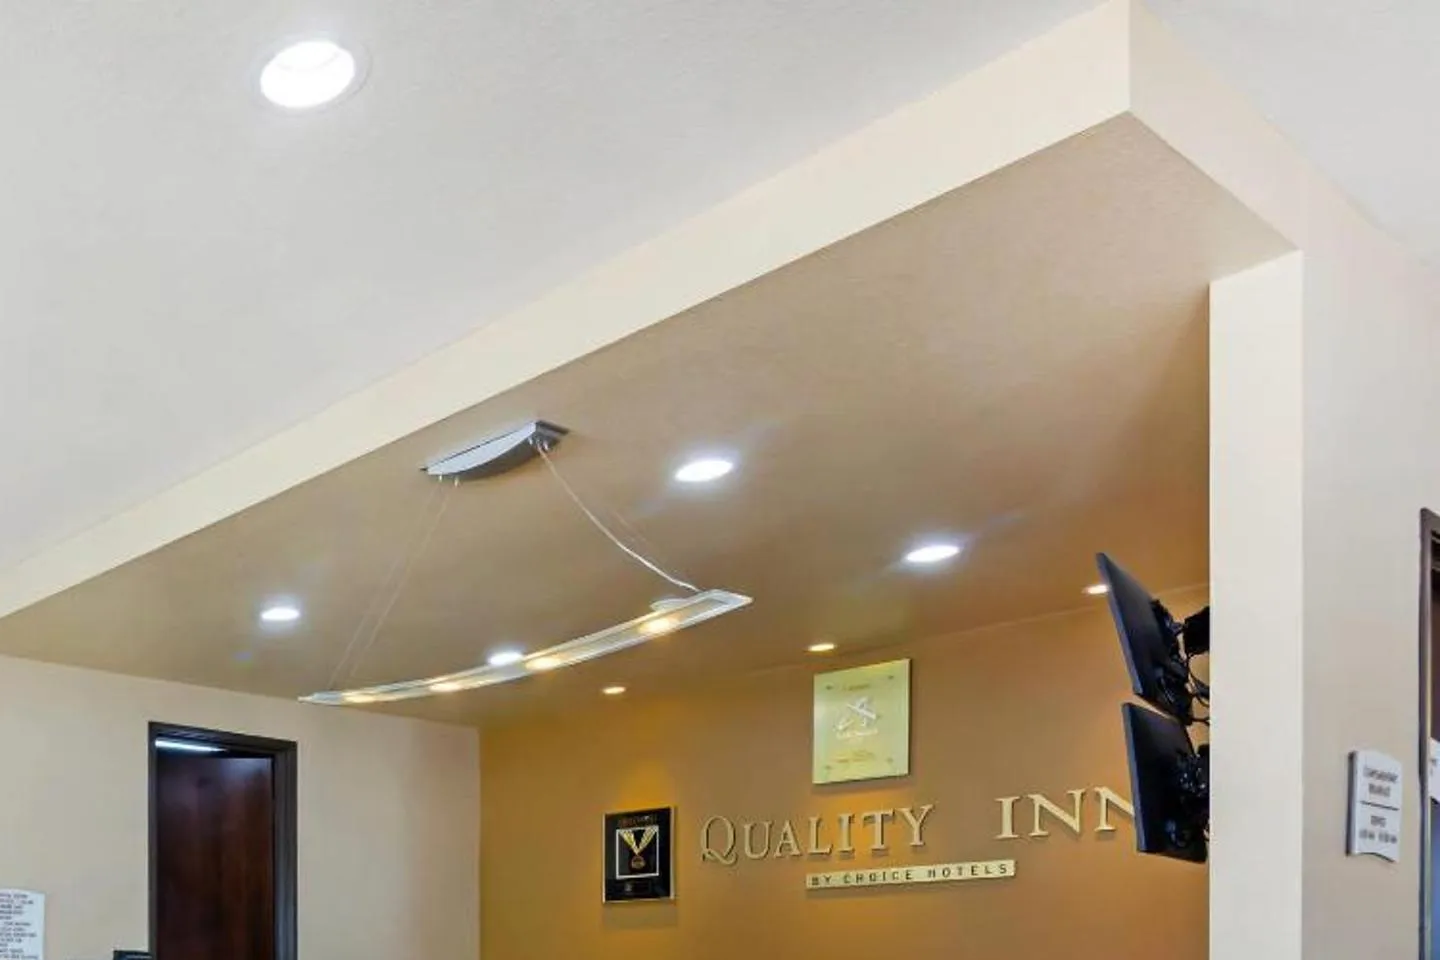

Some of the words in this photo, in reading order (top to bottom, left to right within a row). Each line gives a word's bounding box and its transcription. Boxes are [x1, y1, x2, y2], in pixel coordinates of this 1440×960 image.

[701, 804, 935, 865] QUALITY
[811, 875, 833, 886] BY
[843, 871, 912, 884] CHOICE
[928, 863, 1007, 878] HOTELS
